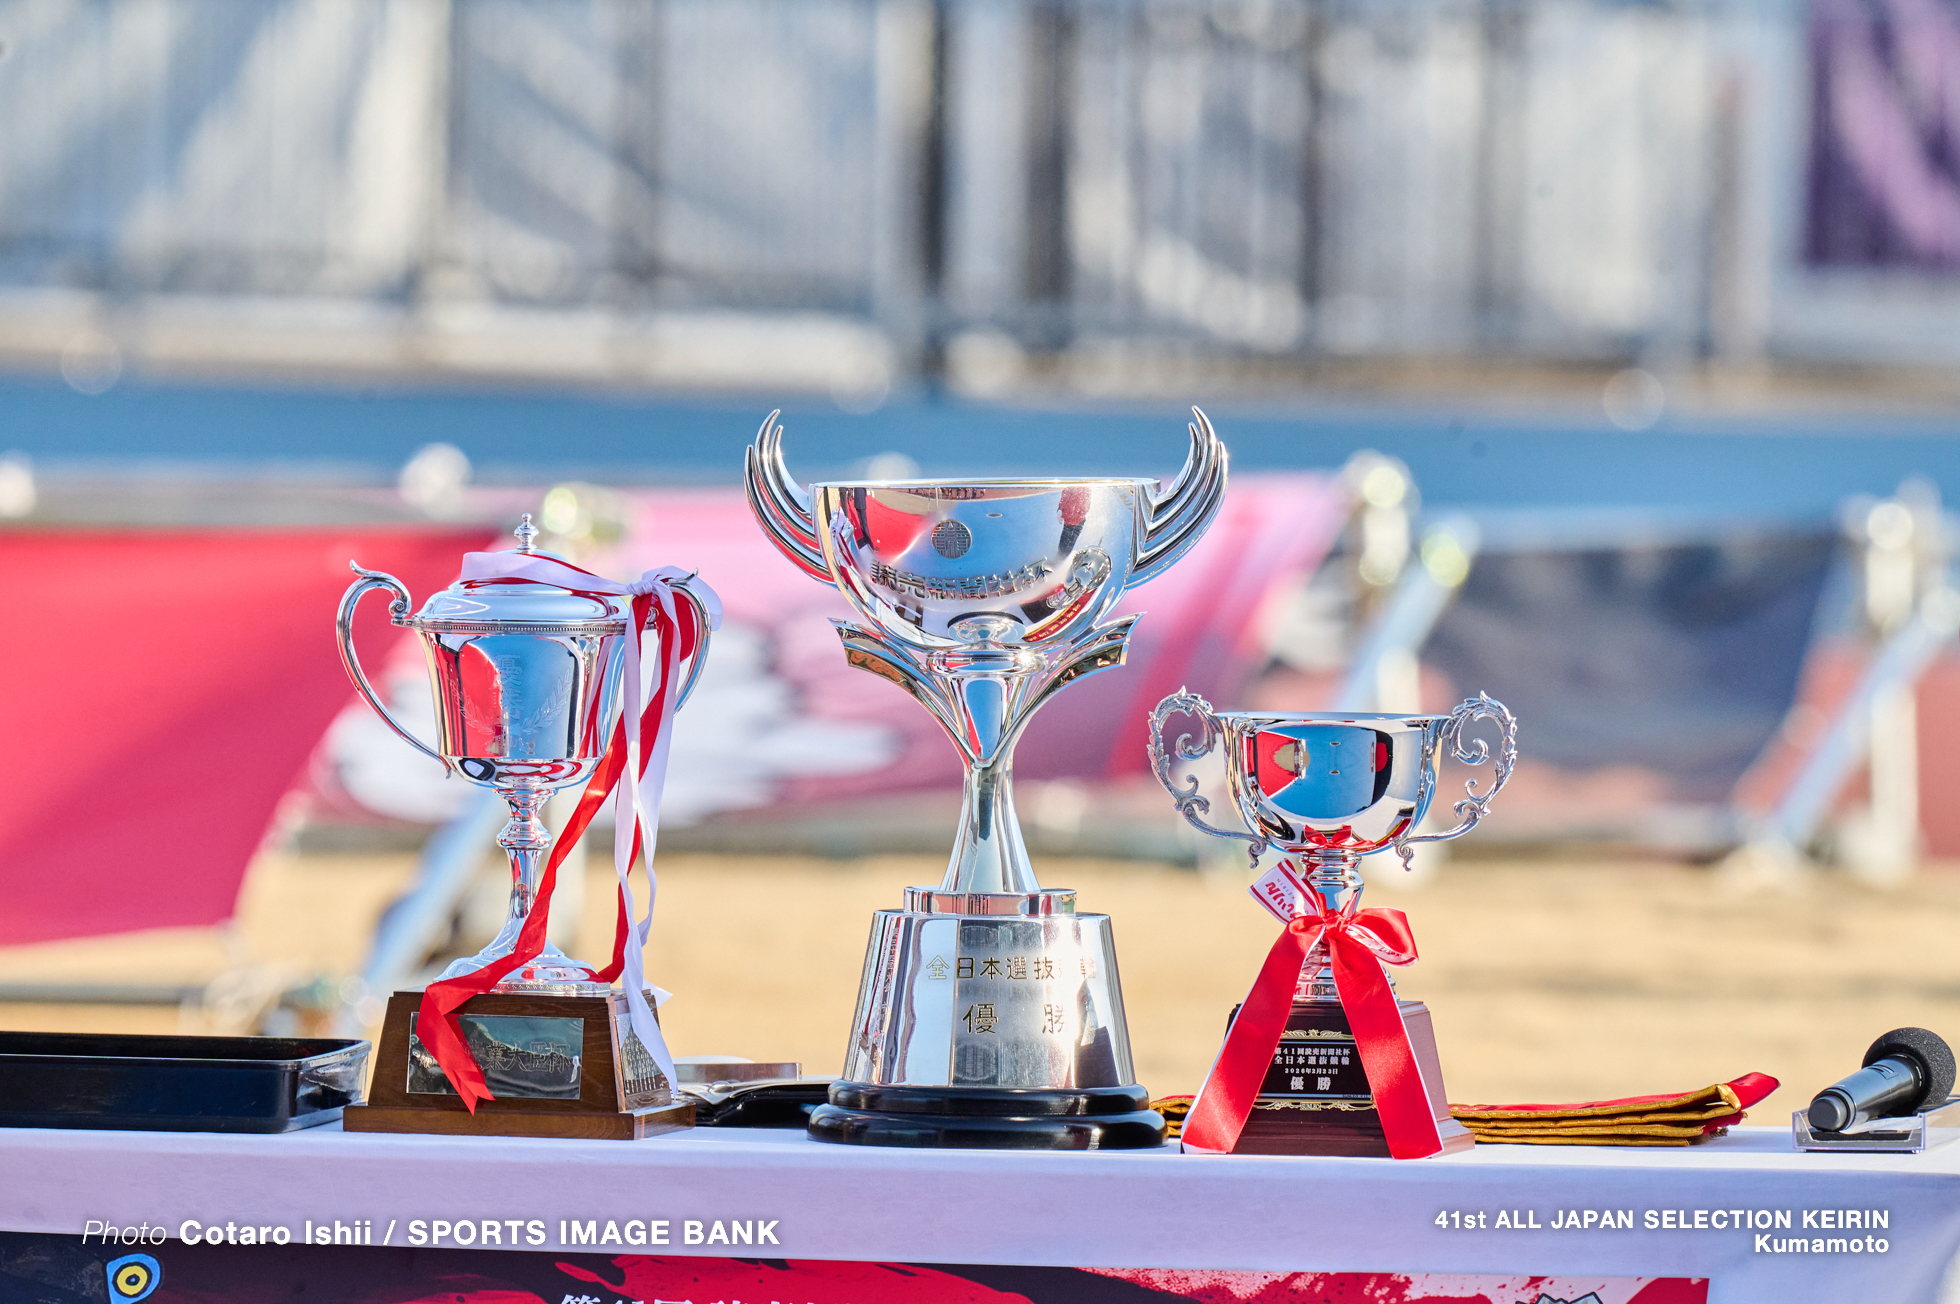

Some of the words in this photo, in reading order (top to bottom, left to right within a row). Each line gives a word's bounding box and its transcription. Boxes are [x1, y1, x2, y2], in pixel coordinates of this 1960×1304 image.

[926, 954, 1097, 981] 全日本選抜輪
